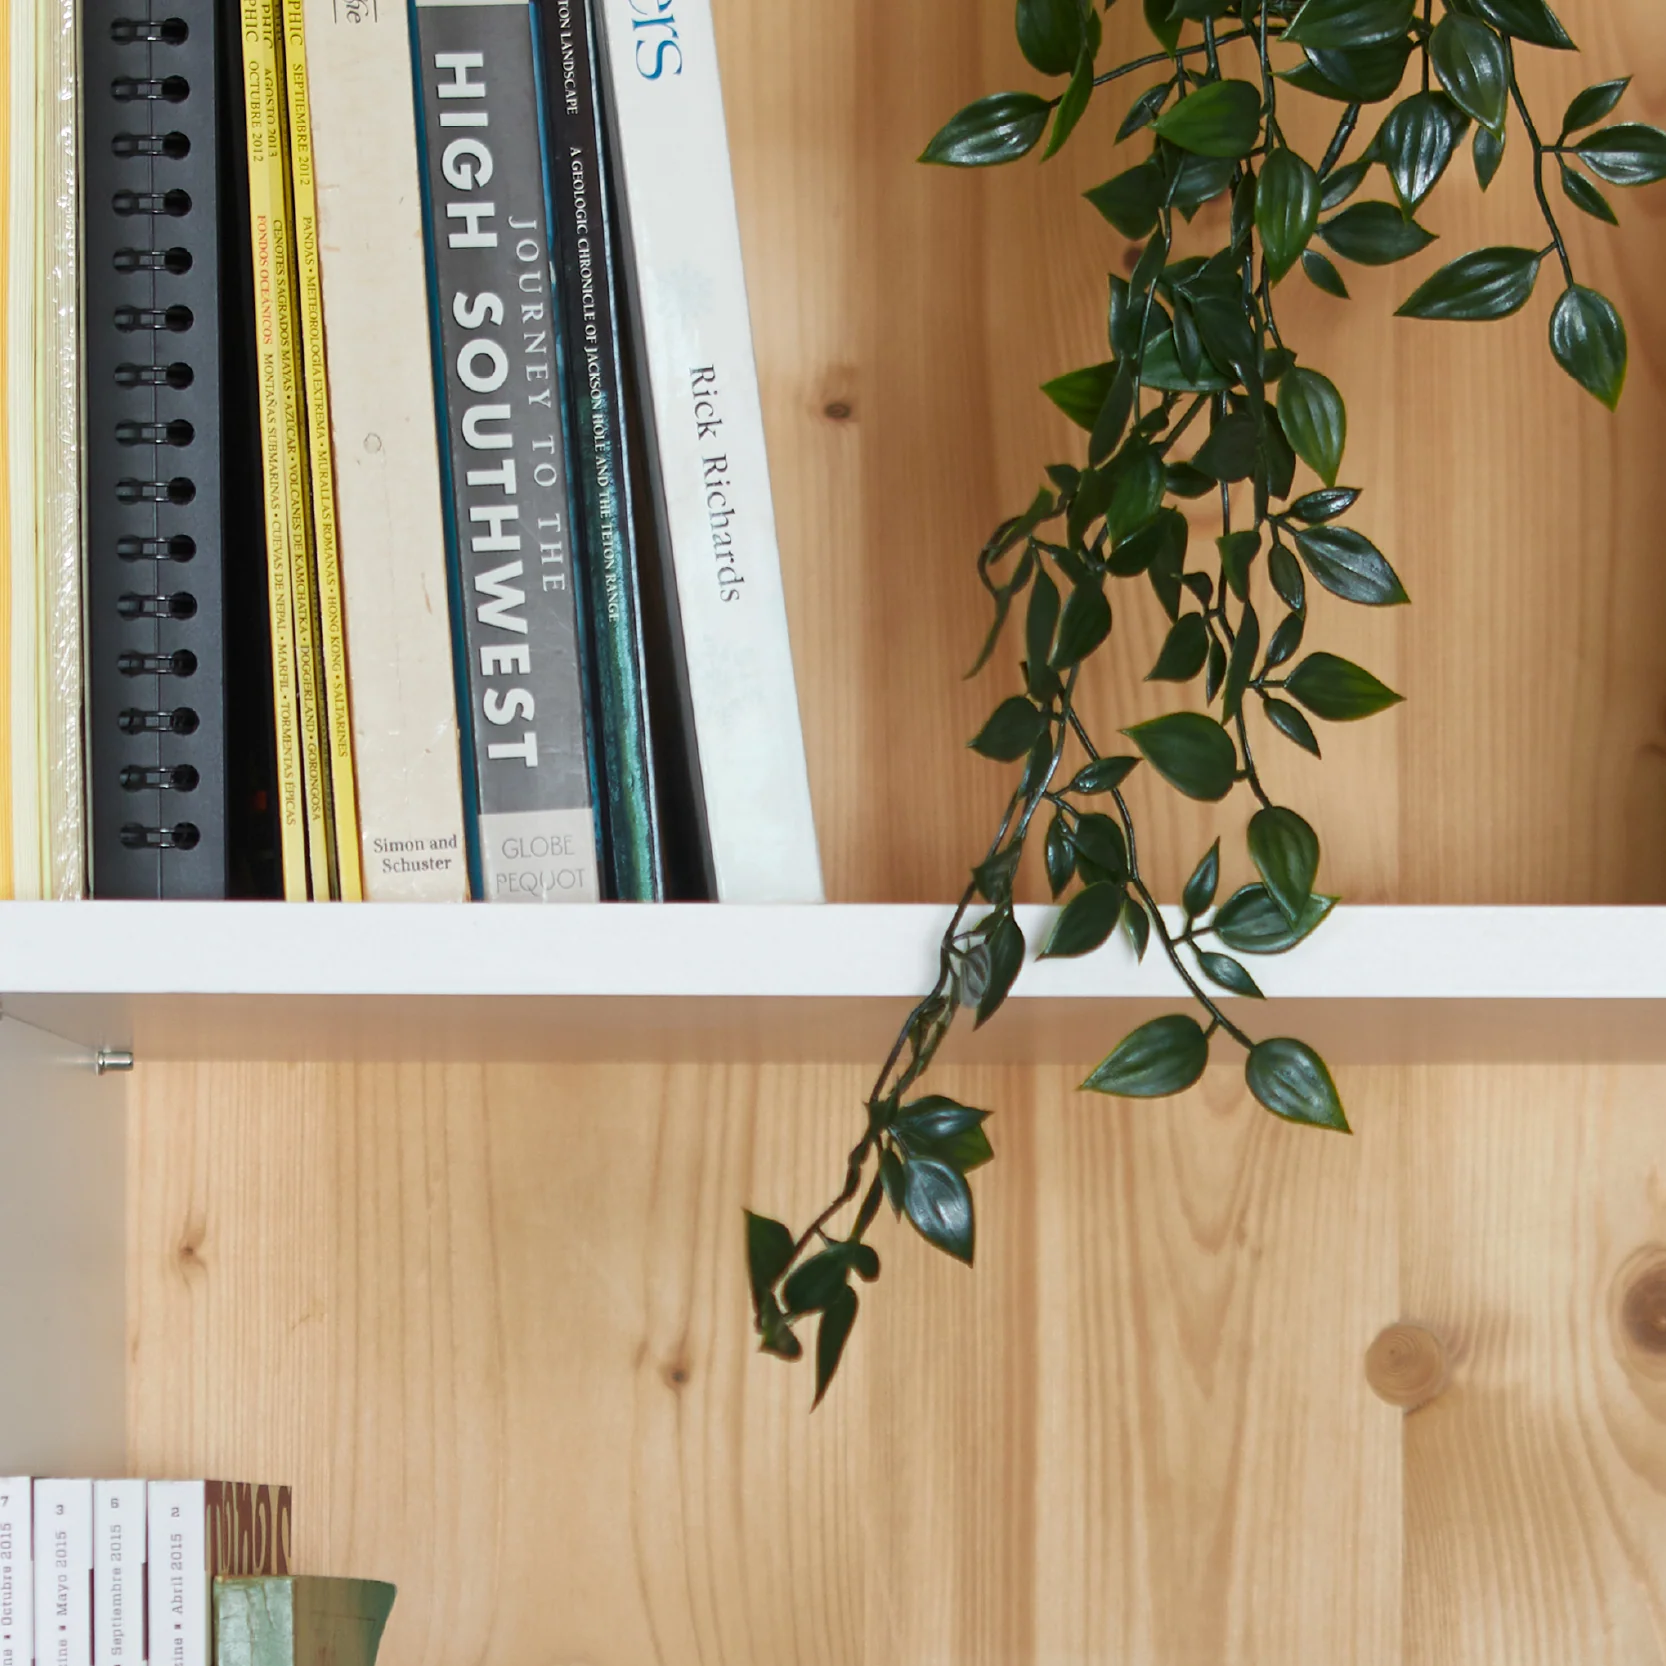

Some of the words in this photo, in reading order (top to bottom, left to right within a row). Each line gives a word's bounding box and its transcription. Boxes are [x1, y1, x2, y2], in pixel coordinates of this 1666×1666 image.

[287, 0, 302, 46] PHIC
[248, 60, 262, 128] OCTUBRE
[560, 32, 577, 115] LANDSCAPE
[292, 63, 307, 152] SEPTIEMBRE
[251, 133, 263, 162] 2012
[298, 156, 309, 185] 2012
[434, 50, 498, 250] HIGH
[569, 146, 580, 156] A
[571, 159, 586, 233] GEOLOGIC
[256, 215, 268, 266] FONDOS
[302, 216, 314, 265] PANDAS
[577, 237, 593, 320] CHRONICLE
[305, 275, 323, 377] METEOROLOGÍA
[508, 213, 552, 411] JOURNEY
[263, 353, 277, 423] MONTAÑAS
[312, 378, 326, 439] EXTREMA
[584, 345, 601, 410] JACKSON
[688, 363, 724, 440] Rick
[267, 427, 280, 510] SUBMARINAS
[317, 450, 331, 520] MURALLAS
[529, 434, 558, 488] TO
[288, 464, 302, 530] VOLCANES
[700, 453, 747, 602] Richards
[271, 520, 283, 570] CUEVAS
[322, 522, 335, 585] ROMANAS
[451, 288, 538, 770] SOUTHWEST
[536, 512, 565, 592] THE
[274, 593, 286, 632] NEPAL
[294, 553, 308, 634] KAMCHATKA
[326, 596, 338, 632] HONG
[277, 643, 289, 691] MARFIL
[329, 636, 341, 671] KONG
[280, 702, 293, 778] TORMENTAS
[333, 682, 347, 757] SALTARINES
[374, 838, 424, 853] Simon
[429, 834, 458, 850] and
[382, 855, 452, 873] Schuster
[502, 834, 575, 860] GLOBE
[496, 868, 585, 897] PEQUOT
[55, 1530, 66, 1568] 2015
[109, 1523, 121, 1562] 2015
[170, 1532, 182, 1570] 2015
[55, 1573, 68, 1616] Mayo
[109, 1567, 124, 1655] Septiembre
[170, 1576, 183, 1614] Abril
